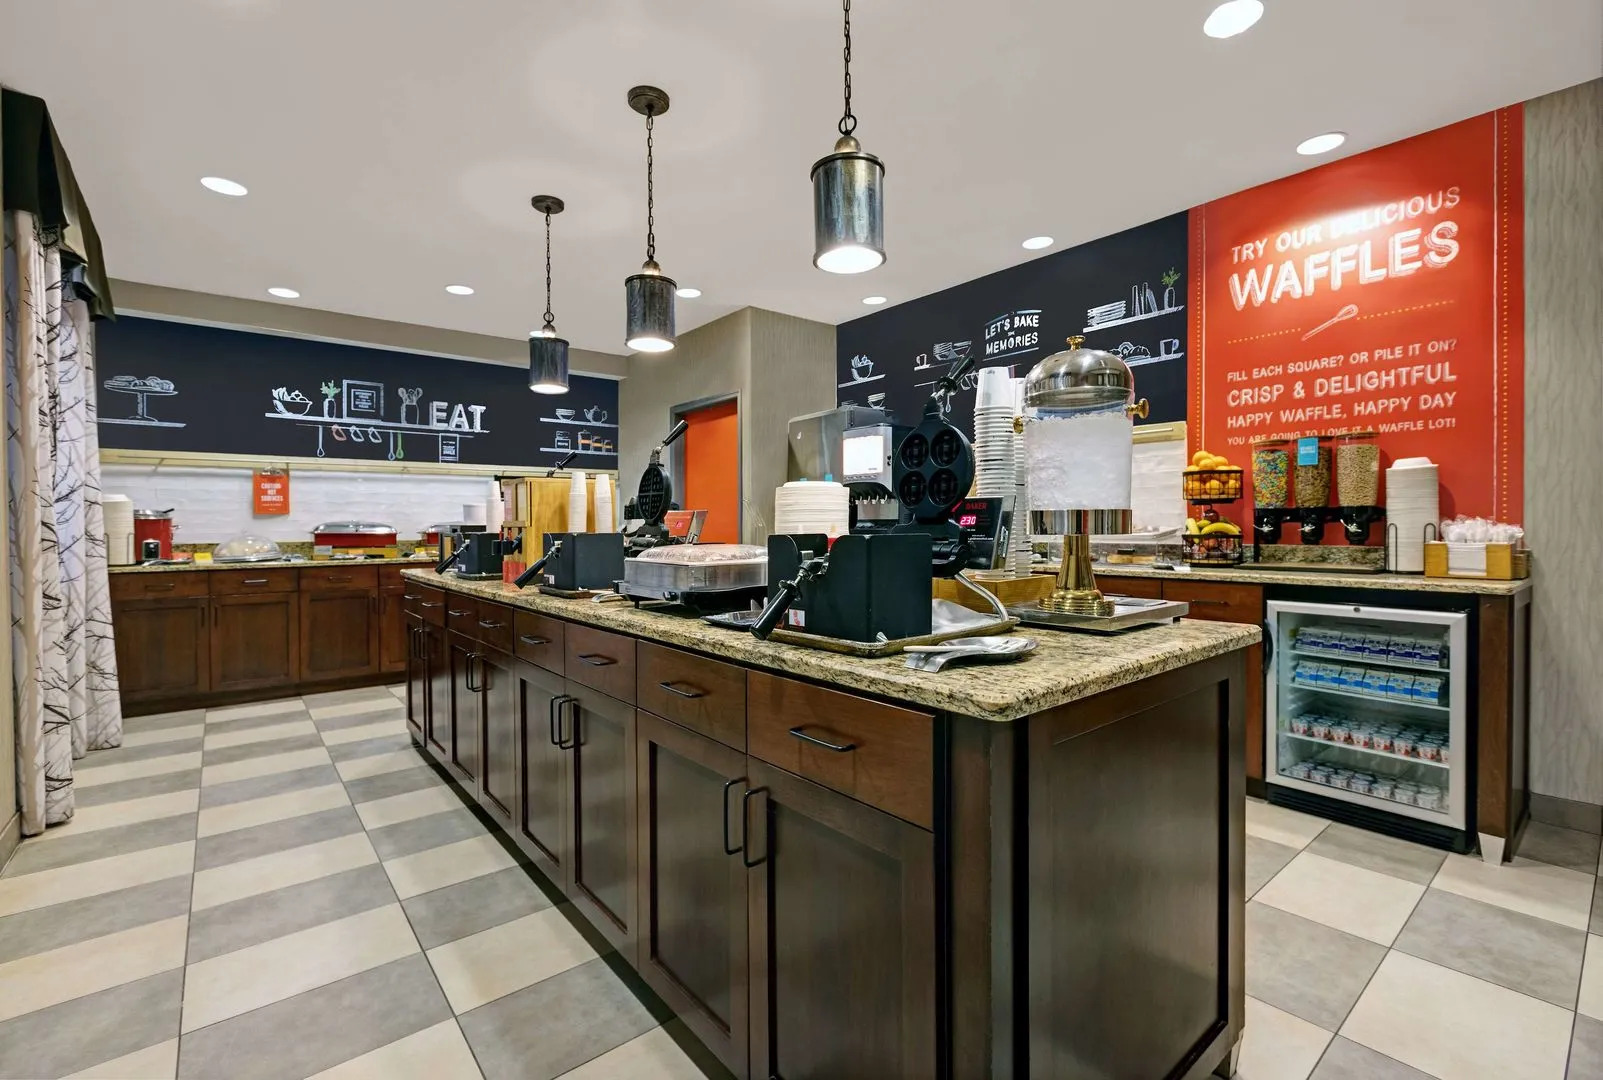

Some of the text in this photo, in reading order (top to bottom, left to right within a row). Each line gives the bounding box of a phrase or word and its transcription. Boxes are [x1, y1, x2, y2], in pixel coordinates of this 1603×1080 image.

[1231, 238, 1268, 264] TRY
[1275, 224, 1322, 252] OUR
[1228, 220, 1460, 311] WAFFLES
[985, 314, 1040, 340] LET'S BAKE
[985, 331, 1039, 355] MEMORIES
[1227, 339, 1457, 382] FILL EACH SQUARE? OR PILE IT ON?
[1227, 361, 1457, 407] CRISP & DELIGHTFUL
[429, 401, 487, 431] EAT
[1227, 391, 1457, 428] HAPPY WAFFLE, HAPPY DAY
[1227, 436, 1245, 446] YOU
[1248, 433, 1267, 444] ARE
[1270, 431, 1300, 441] GOING
[1305, 429, 1317, 438] TO
[1366, 424, 1374, 433] A
[1379, 420, 1424, 433] WAFFLE
[1428, 417, 1456, 430] LOT!
[959, 515, 977, 526] 230
